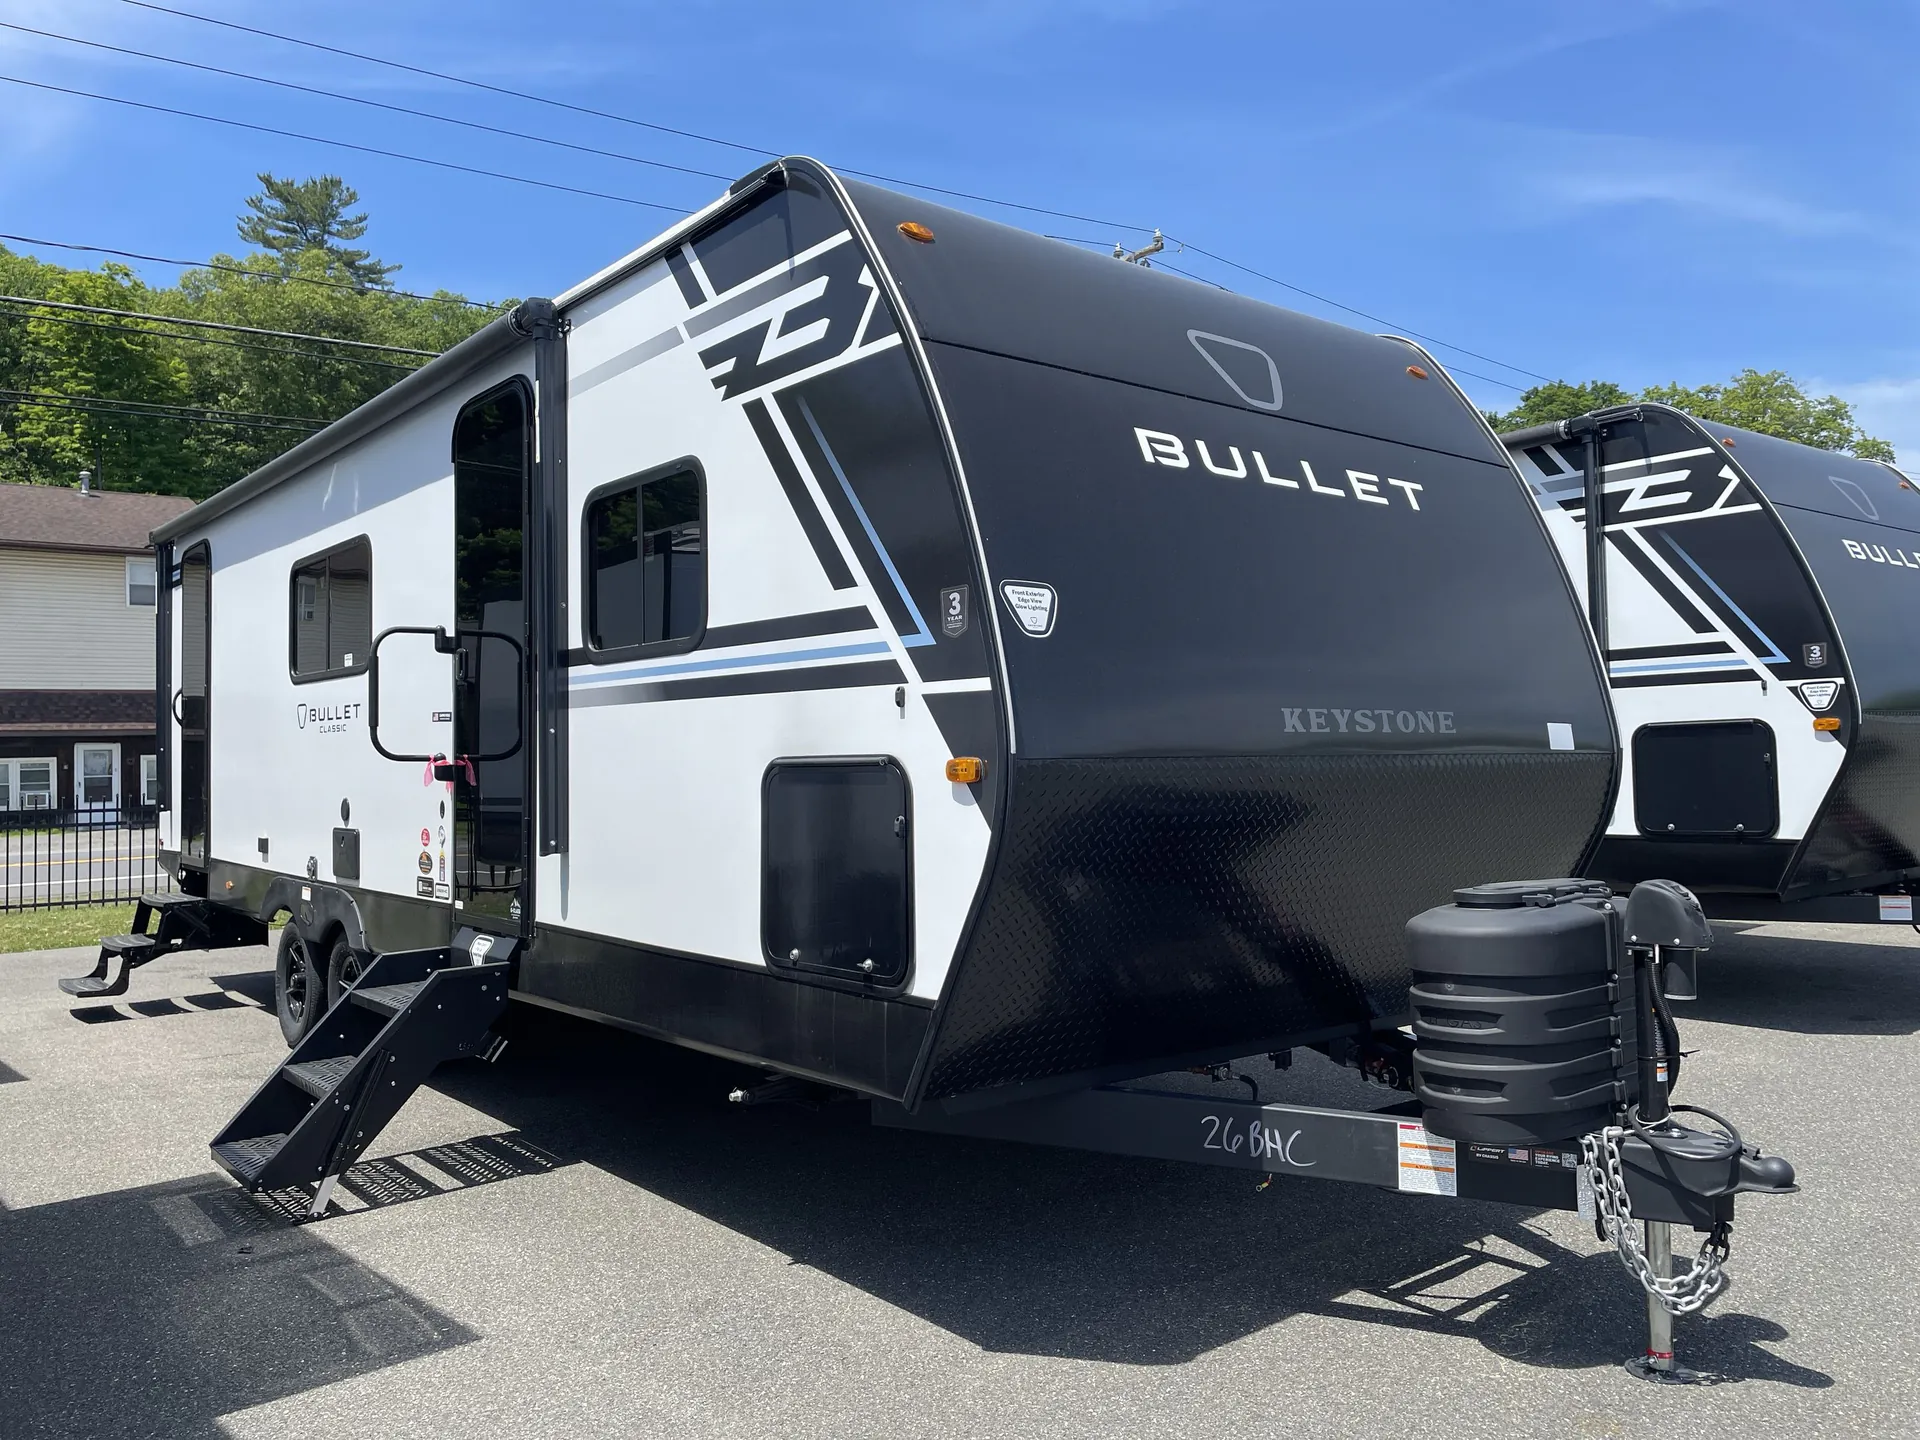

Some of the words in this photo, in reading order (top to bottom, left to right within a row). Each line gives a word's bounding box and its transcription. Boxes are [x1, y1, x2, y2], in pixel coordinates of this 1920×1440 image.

[1133, 426, 1424, 511] BULLET
[948, 592, 961, 616] 3
[1027, 604, 1048, 612] Lighting
[1810, 645, 1821, 658] 3
[309, 703, 361, 723] BULLET
[1281, 707, 1457, 734] KEYSTONE
[319, 723, 347, 734] CLASSIC
[1477, 1146, 1506, 1154] LIPPERT
